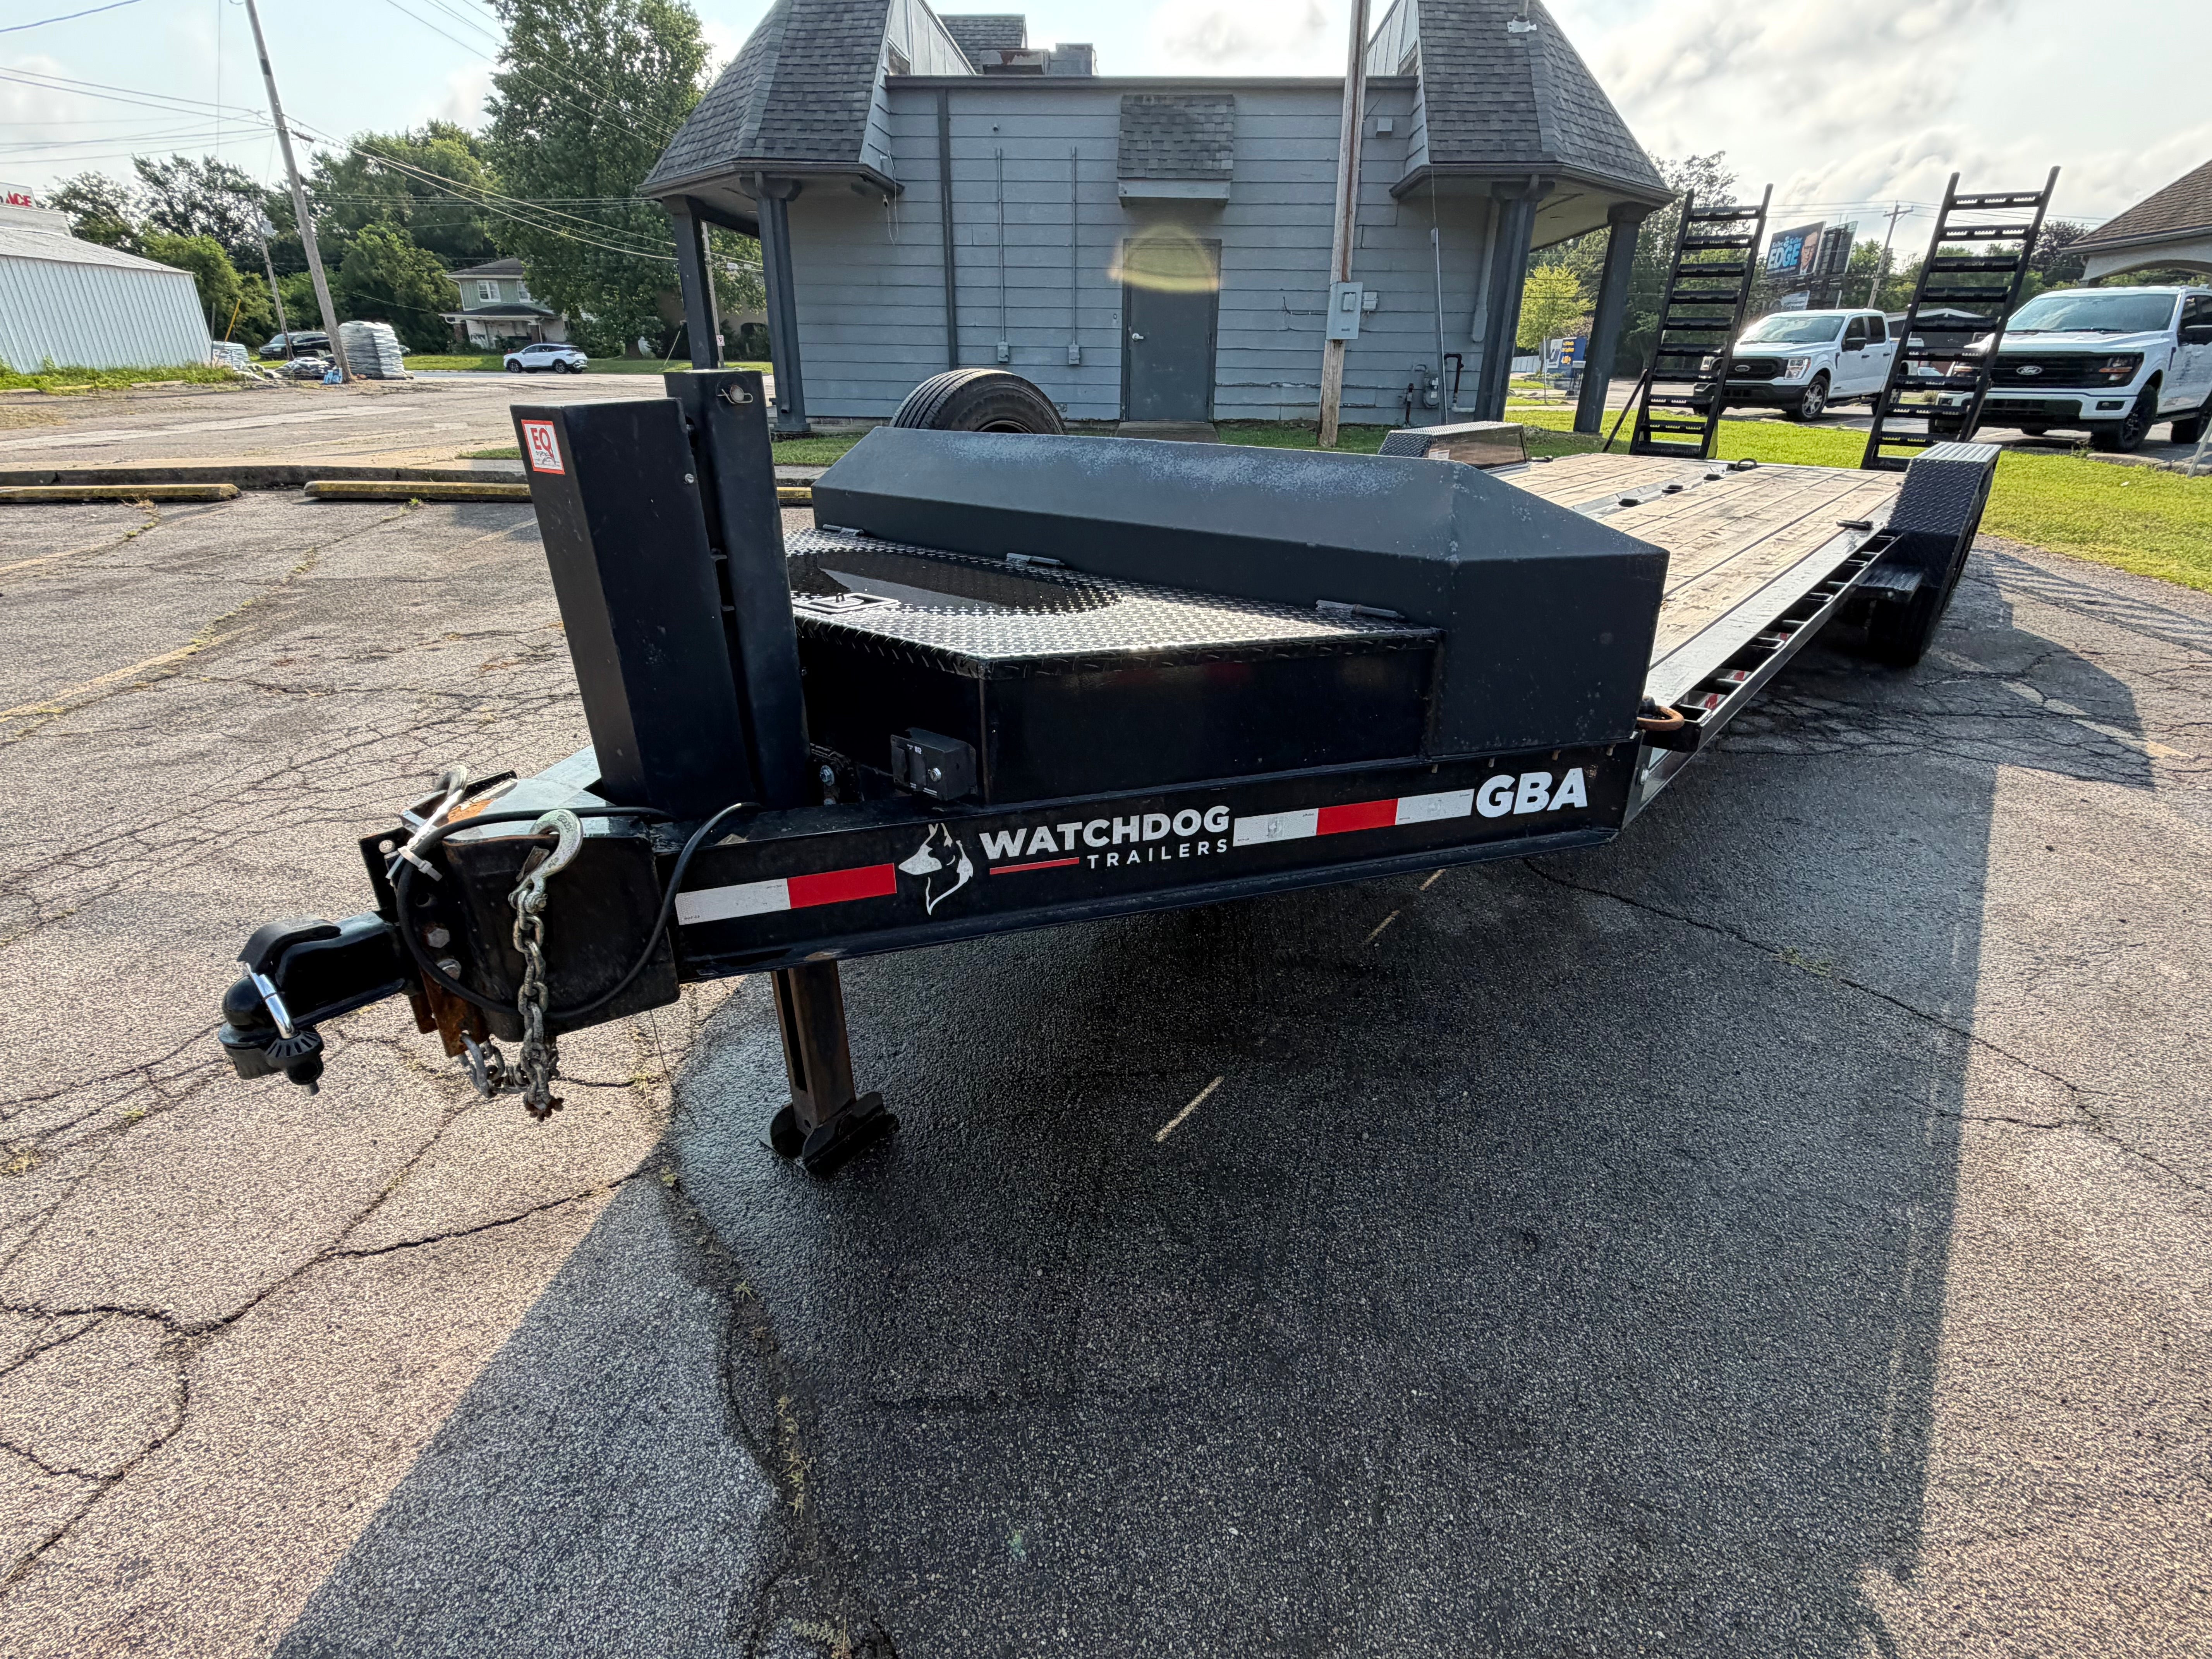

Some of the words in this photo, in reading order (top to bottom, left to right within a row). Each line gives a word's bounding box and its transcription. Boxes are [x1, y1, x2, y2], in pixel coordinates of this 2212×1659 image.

[6, 191, 32, 207] ACE
[1767, 243, 1801, 270] EDGE
[1783, 236, 1790, 248] &
[530, 428, 554, 457] EQ
[1476, 768, 1587, 818] GBA
[979, 805, 1230, 860] WATCHDOG
[1087, 839, 1227, 869] TRAILERS
